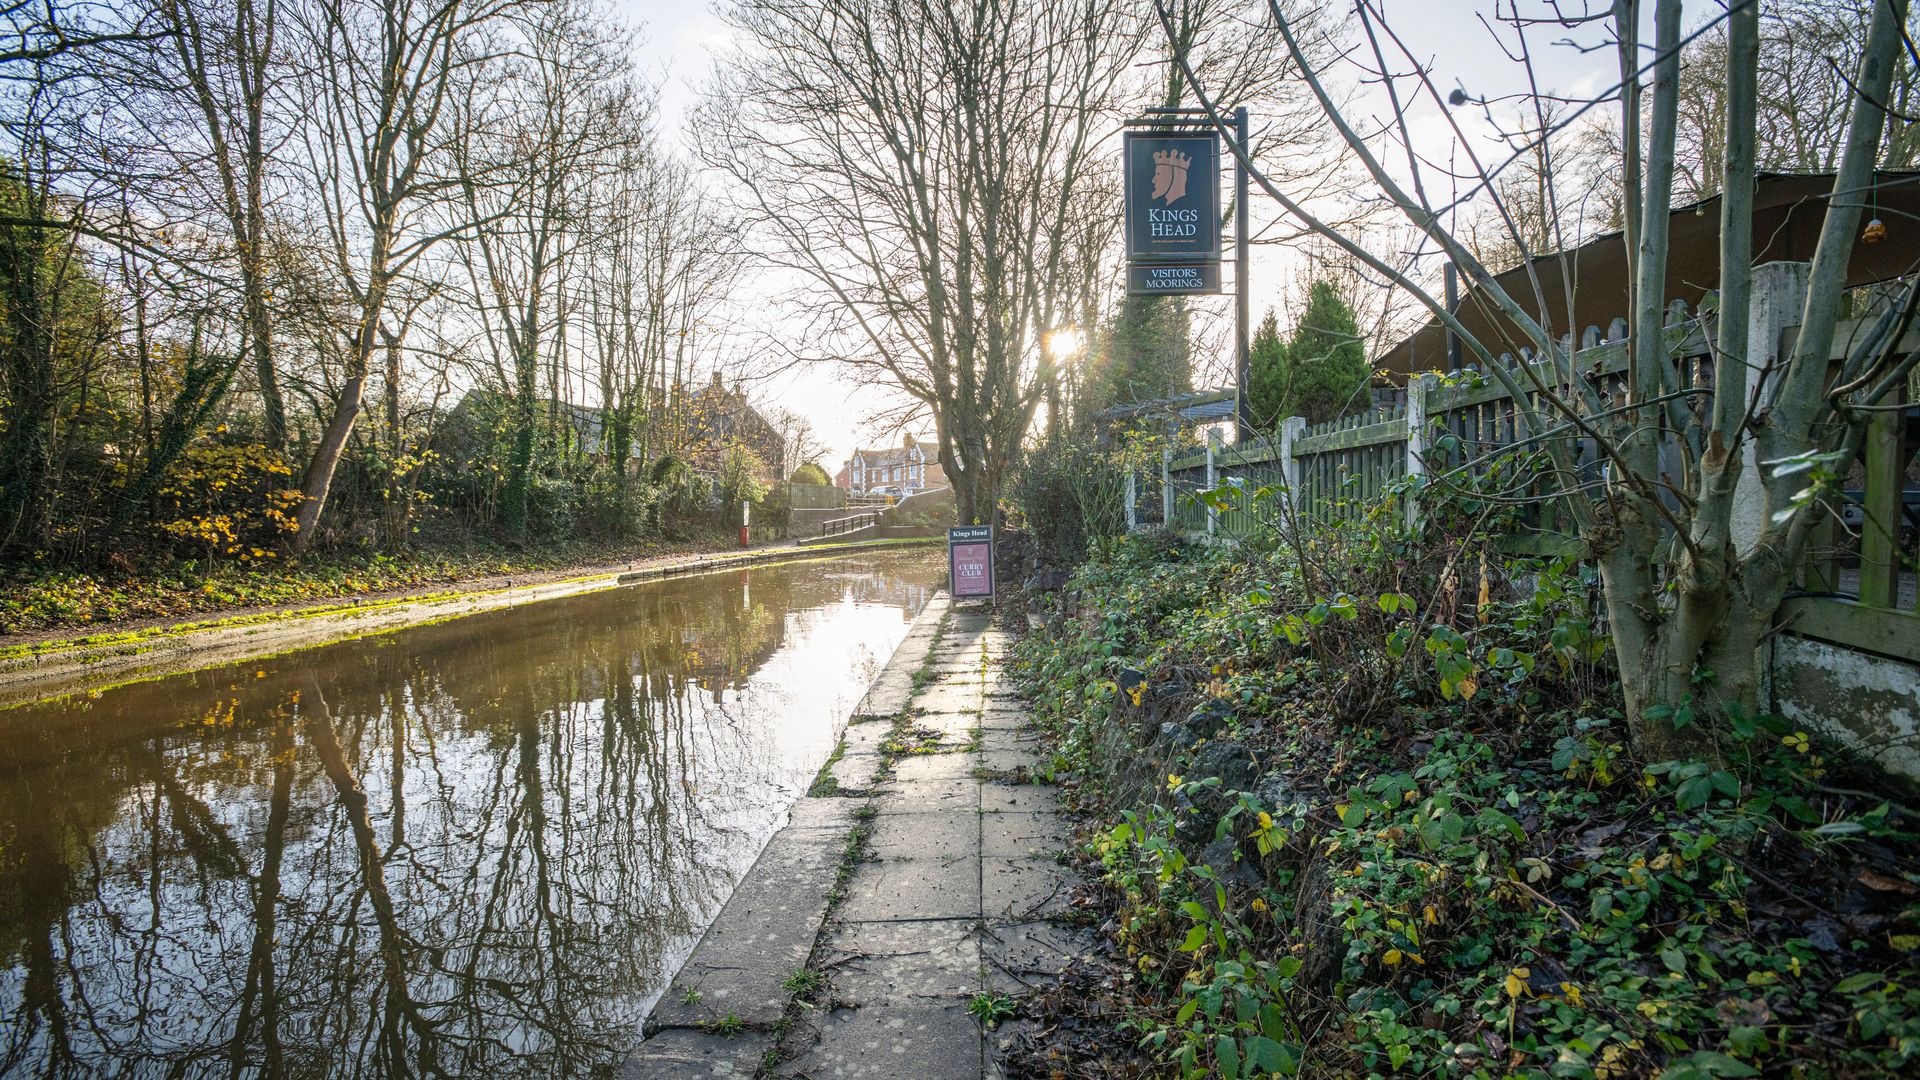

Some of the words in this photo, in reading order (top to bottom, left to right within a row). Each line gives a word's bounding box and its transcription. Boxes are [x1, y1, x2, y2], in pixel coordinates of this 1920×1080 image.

[1148, 208, 1198, 222] KINGS
[1151, 223, 1196, 236] HEAD
[1151, 269, 1197, 278] VISITORS
[1146, 278, 1203, 288] MOORINGS
